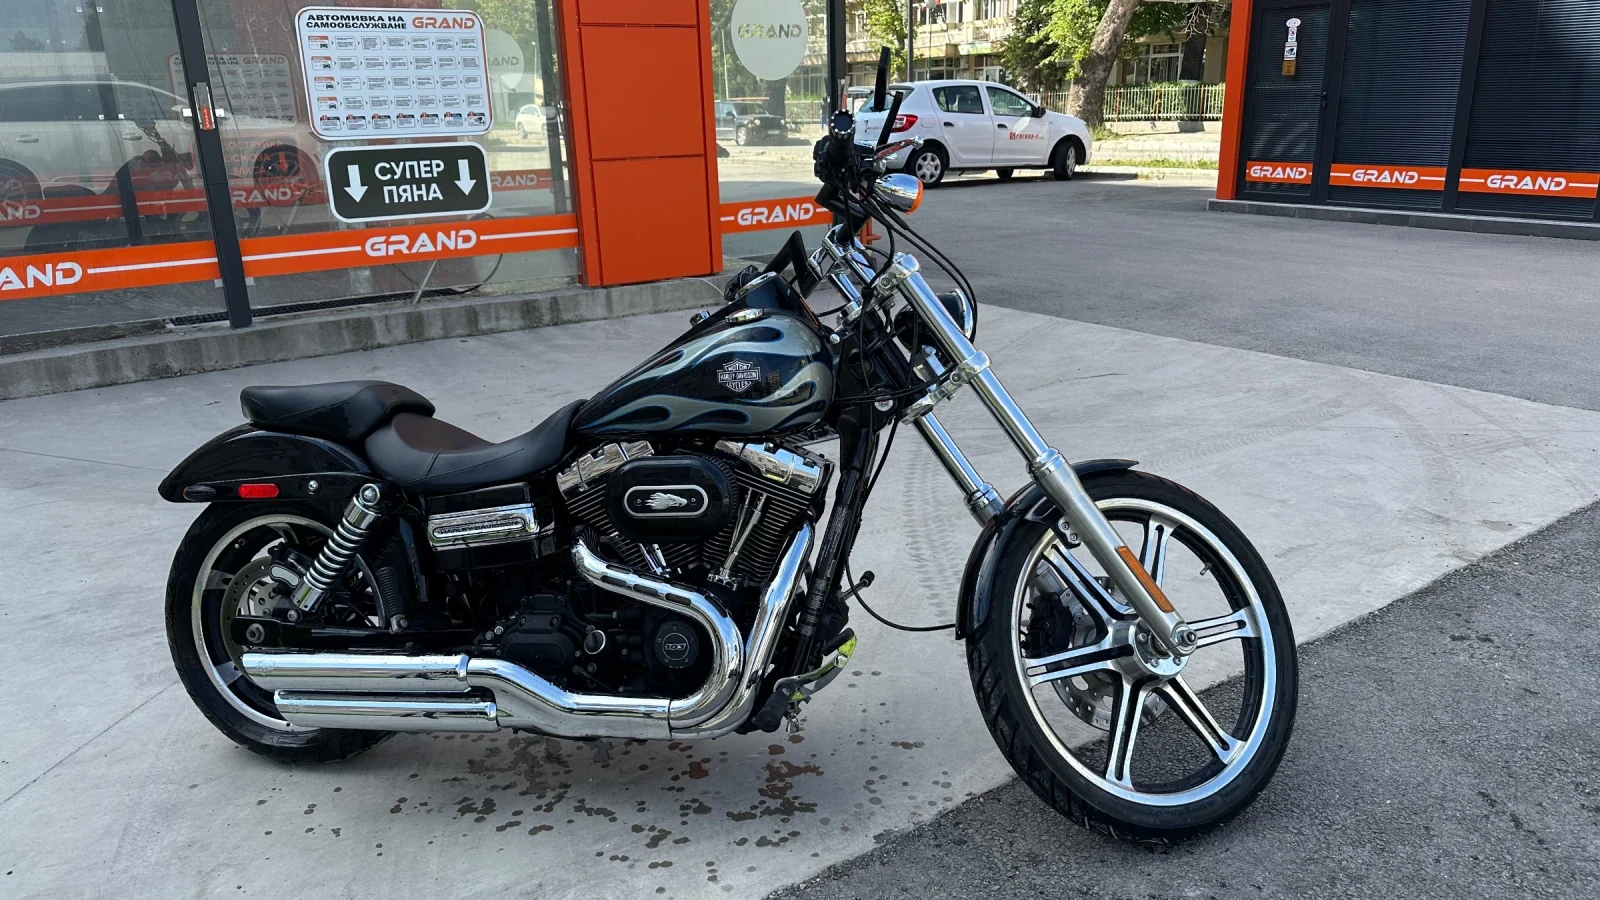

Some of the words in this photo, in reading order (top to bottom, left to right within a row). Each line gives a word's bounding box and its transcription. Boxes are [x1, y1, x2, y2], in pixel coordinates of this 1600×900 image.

[306, 21, 407, 30] САМООБСЛУЖВАНЕ
[307, 14, 384, 22] АВТОМИВКА
[388, 15, 405, 23] НА
[412, 16, 476, 29] GRAND
[737, 23, 802, 39] GRAND
[489, 56, 519, 66] AND
[374, 159, 446, 181] СУПЕР
[1250, 165, 1308, 180] GRAND
[1352, 169, 1419, 184] GRAND
[491, 173, 538, 188] RAND
[1486, 175, 1567, 192] GRAND
[231, 187, 292, 204] RAND
[383, 183, 444, 204] ПЯНА
[737, 203, 814, 226] GRAND
[365, 229, 477, 257] GRAND
[0, 262, 83, 291] AND
[728, 363, 748, 371] MOTOR
[720, 371, 757, 381] HARLEY-DAVIDSON
[728, 380, 749, 389] CYCLES
[664, 643, 687, 651] 103
